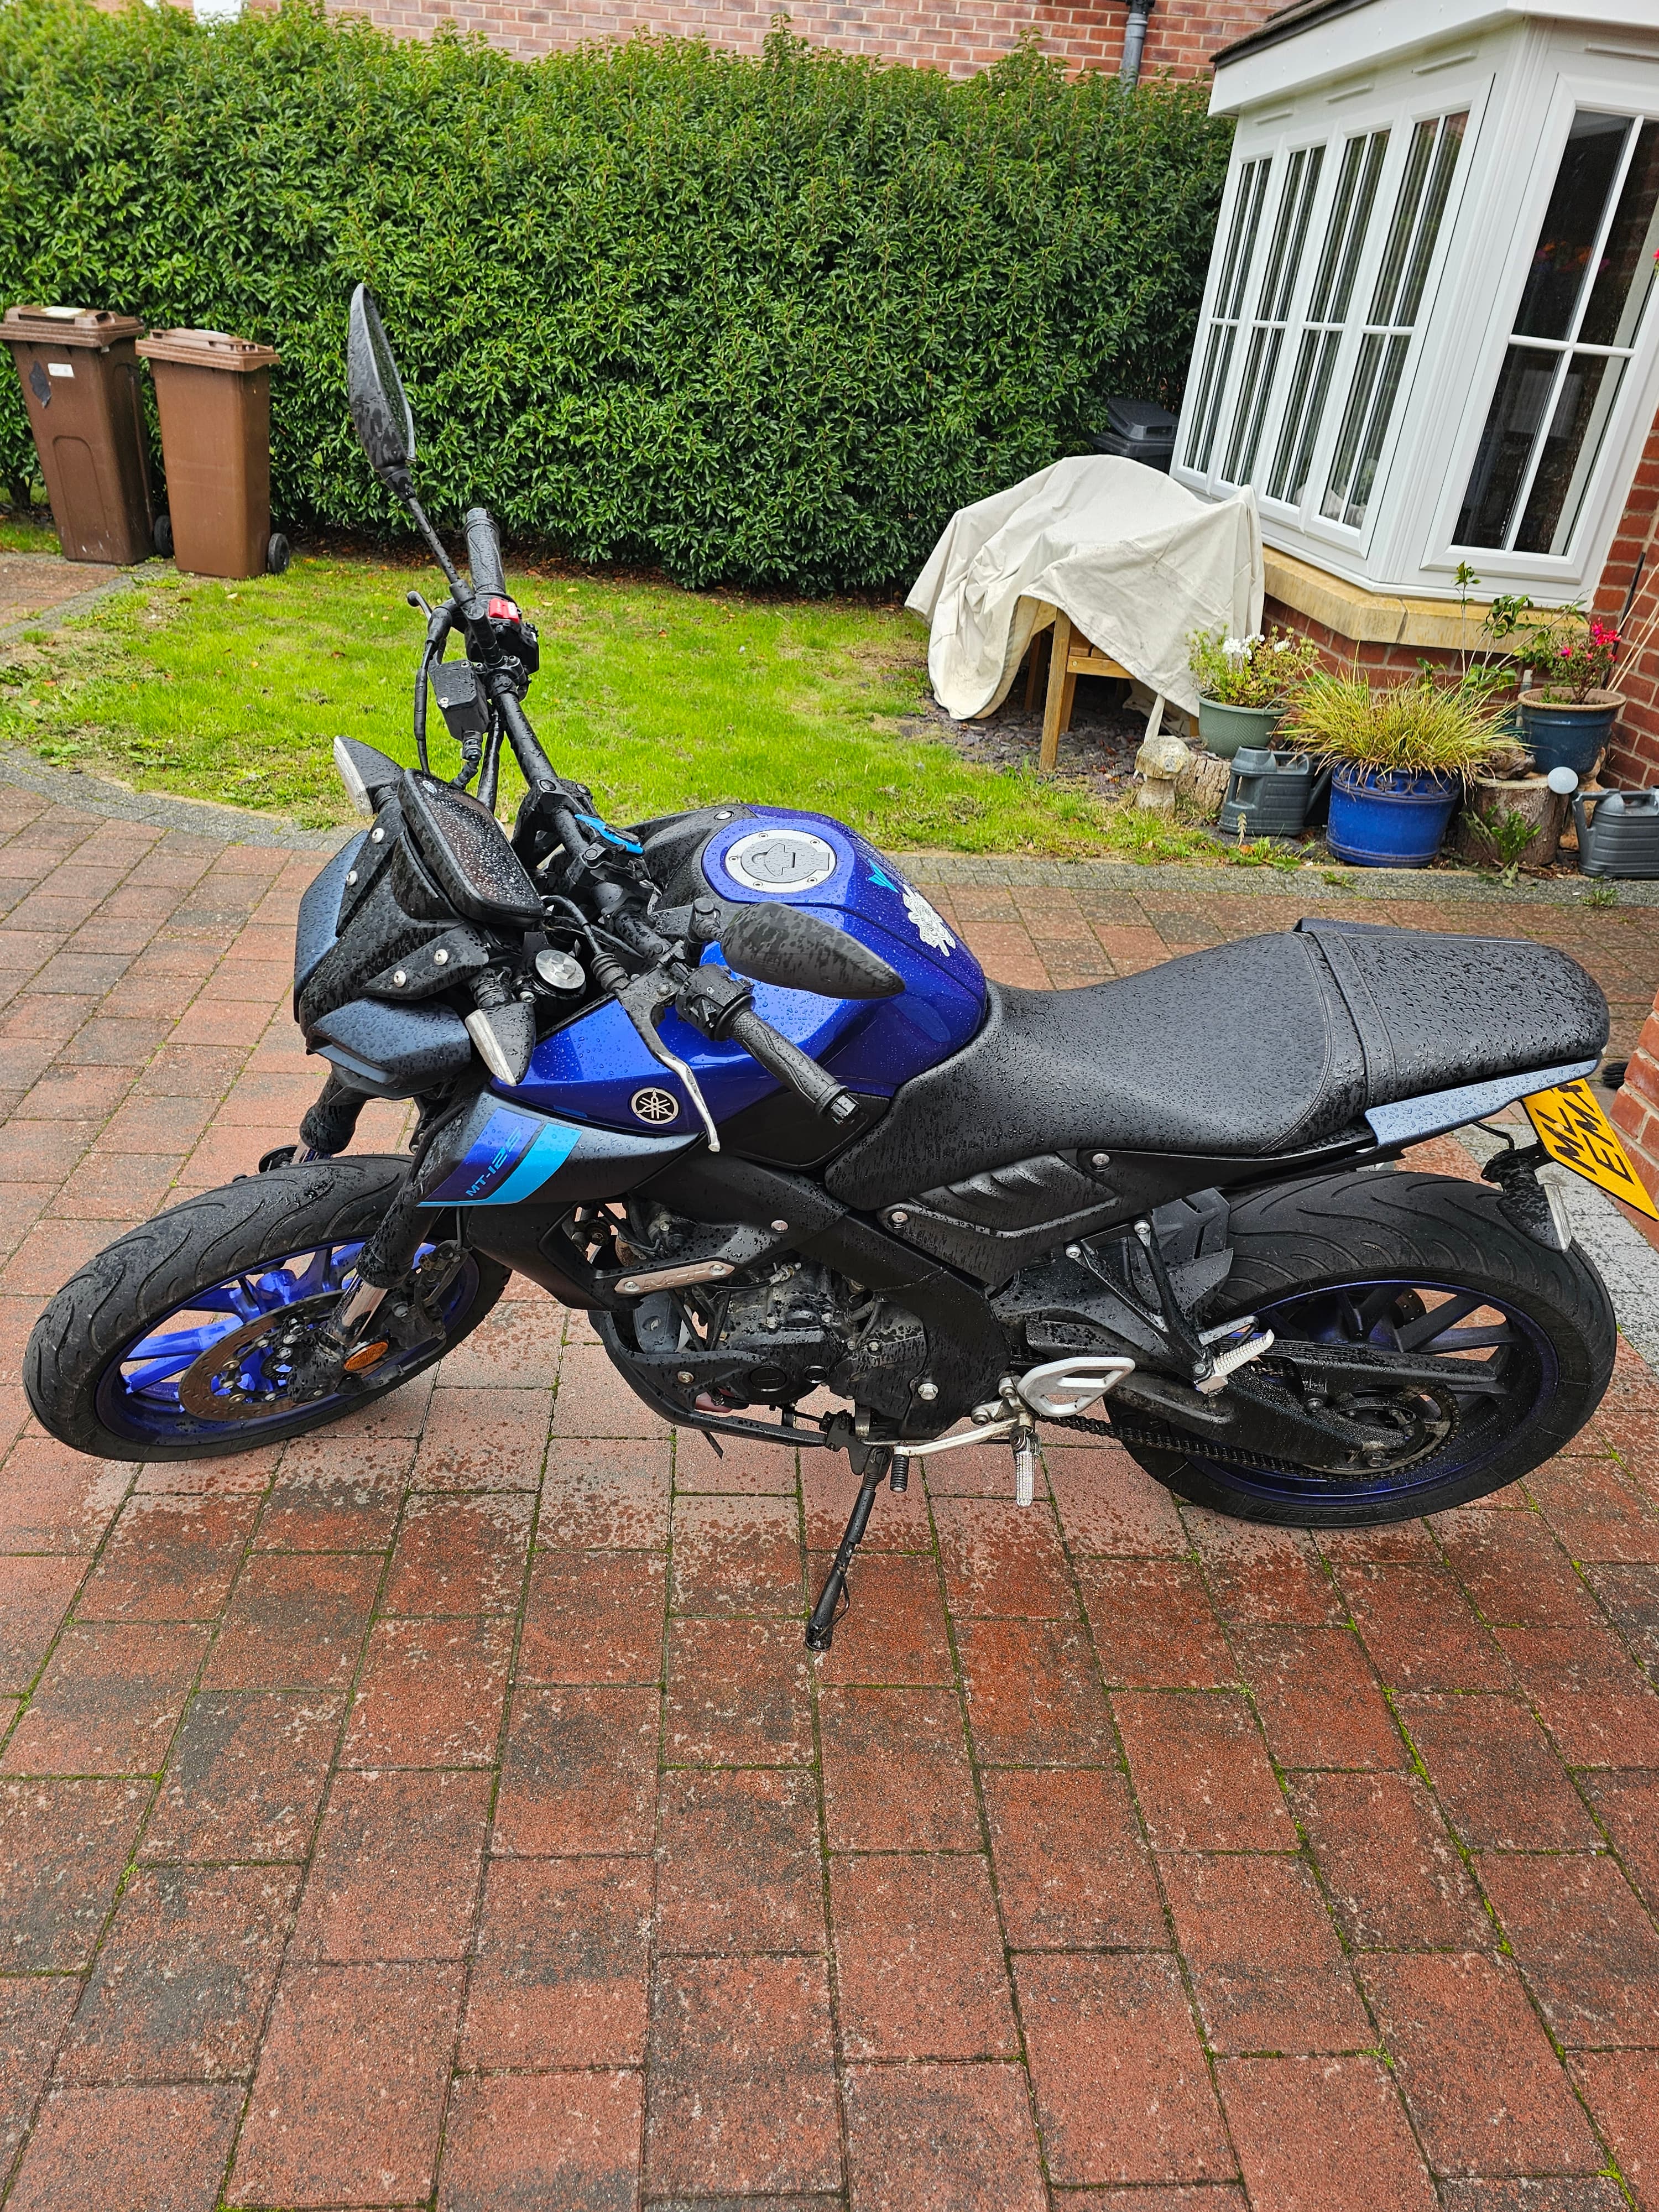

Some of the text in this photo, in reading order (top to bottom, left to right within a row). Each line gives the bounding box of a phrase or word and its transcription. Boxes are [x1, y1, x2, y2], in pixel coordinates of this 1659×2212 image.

[466, 1126, 521, 1197] MT-125
[1535, 1089, 1598, 1176] ML
[644, 1268, 706, 1289] MT
